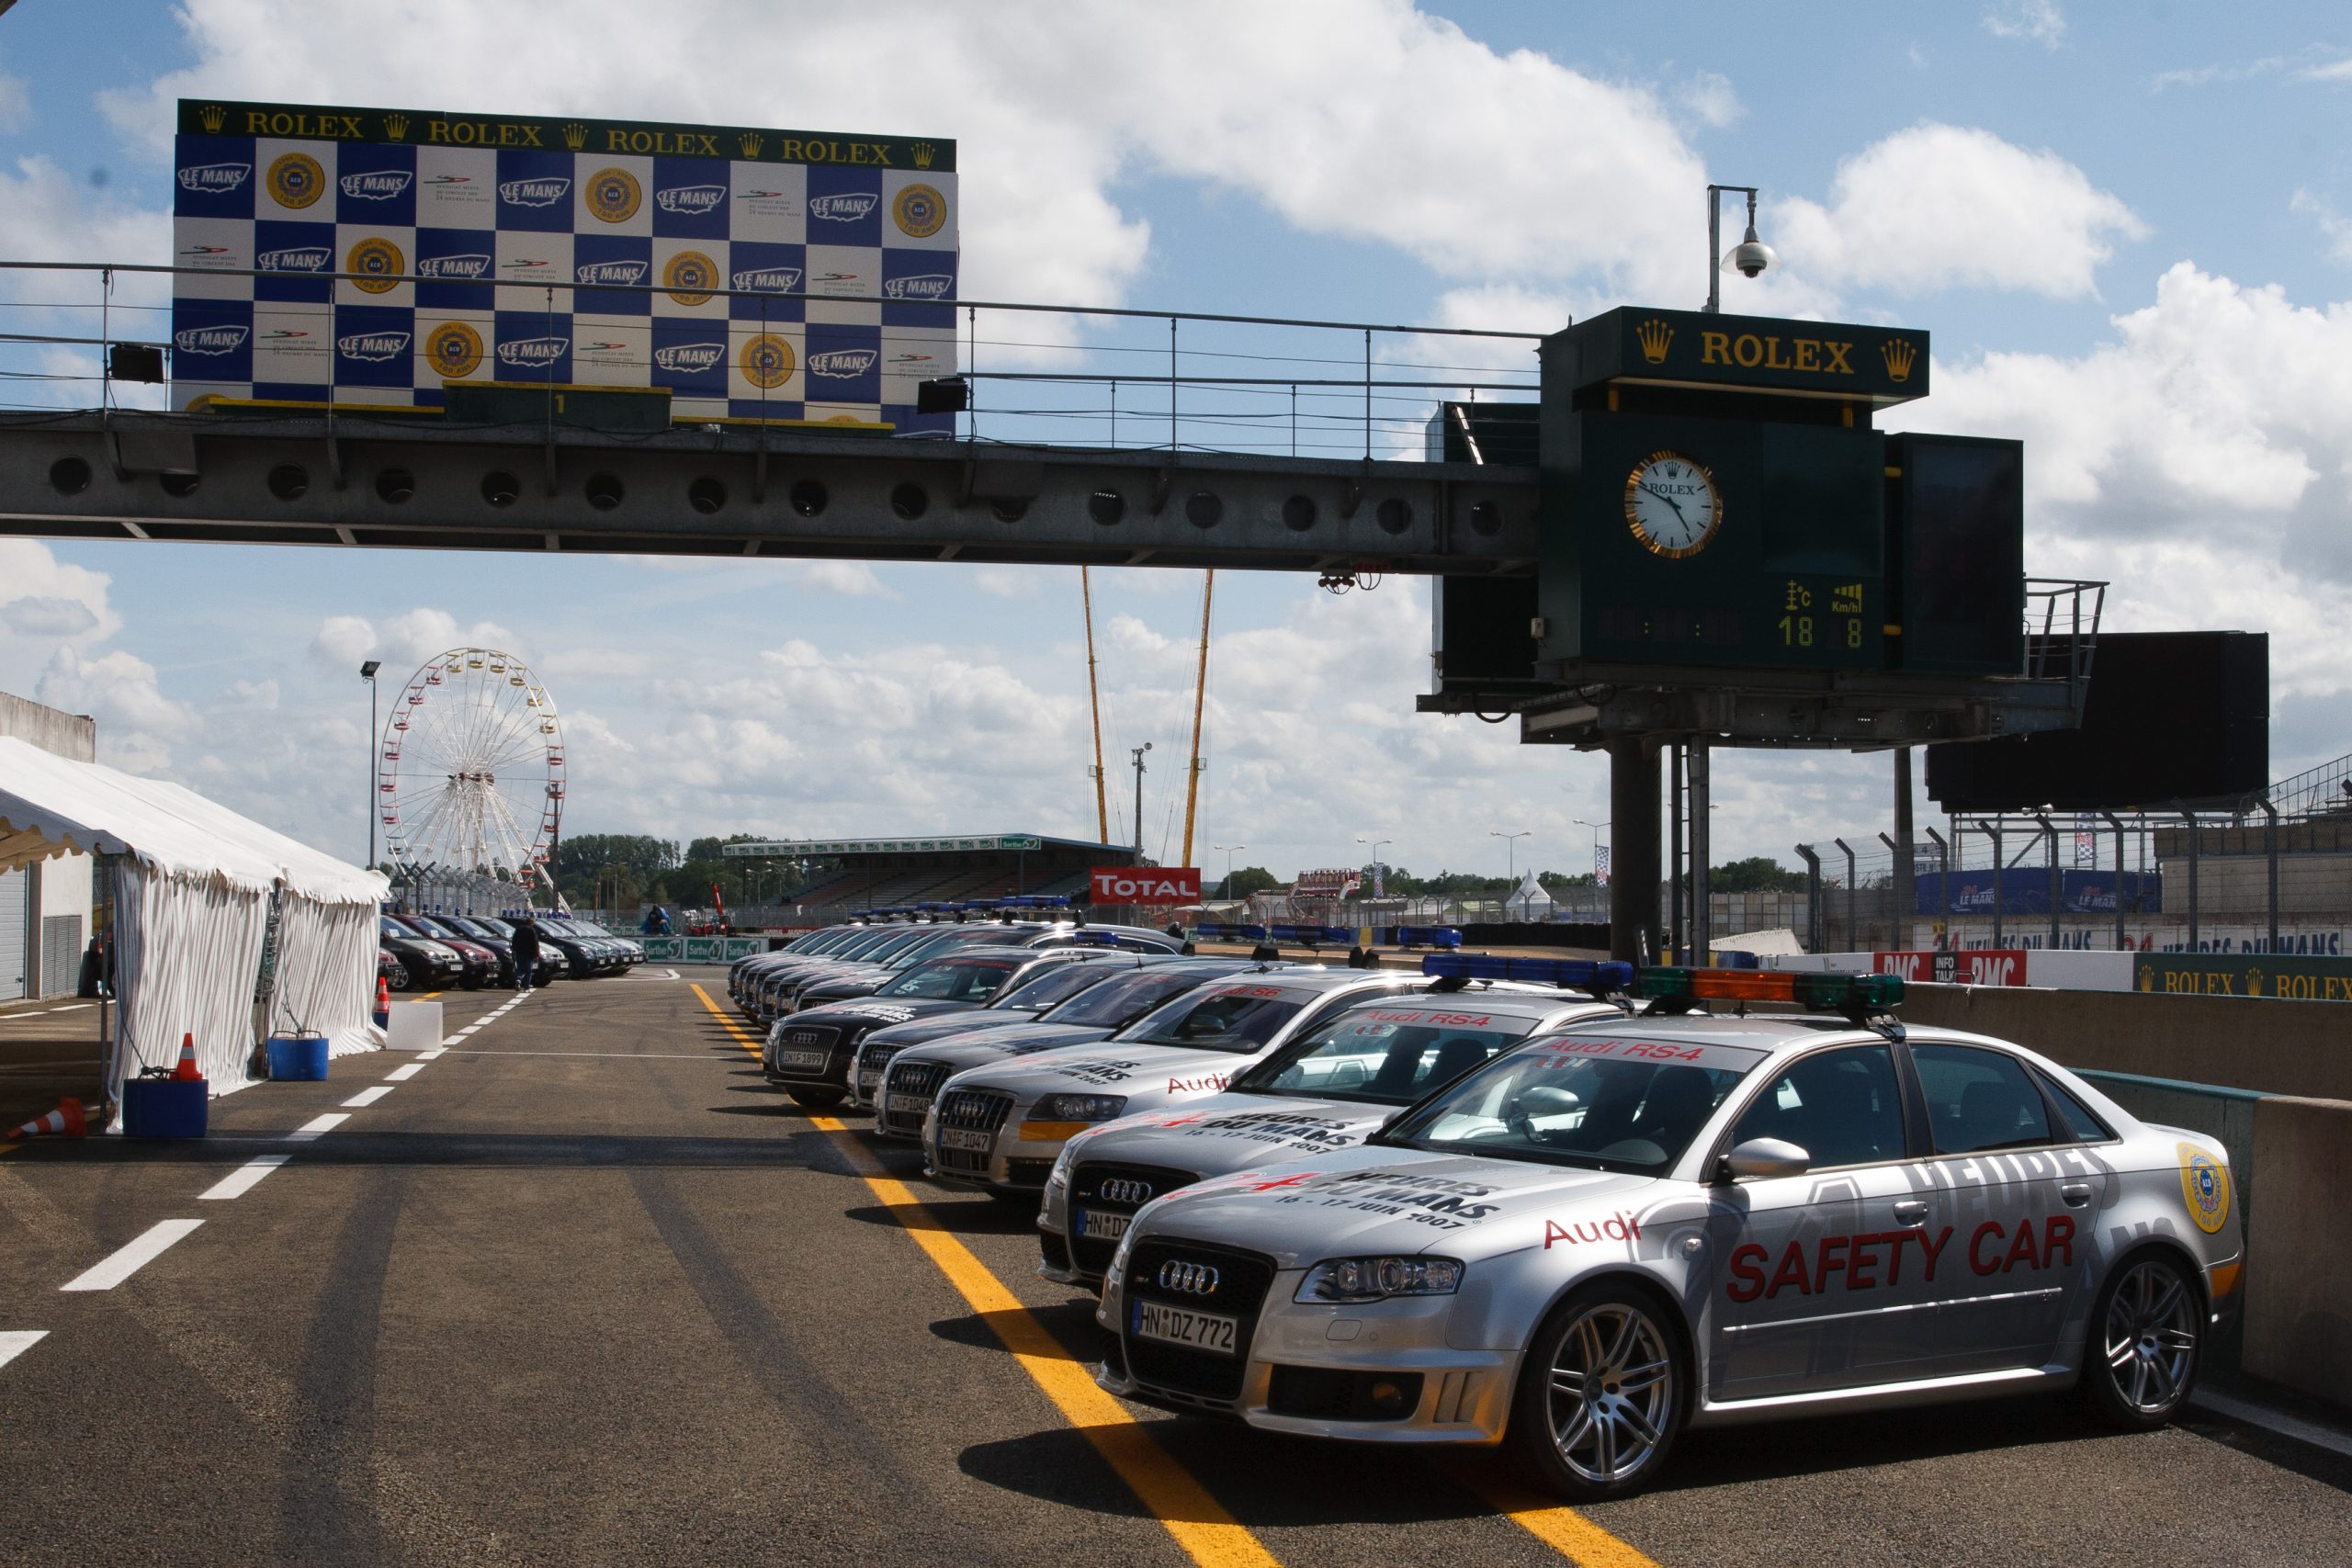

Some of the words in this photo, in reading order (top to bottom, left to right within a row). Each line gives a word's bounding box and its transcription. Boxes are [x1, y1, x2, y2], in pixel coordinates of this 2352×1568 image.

[246, 112, 364, 138] ROLEX
[429, 120, 543, 146] ROLEX
[607, 130, 719, 156] ROLEX
[782, 139, 892, 165] ROLEX
[184, 169, 198, 182] LE
[201, 170, 243, 183] MANS
[346, 176, 361, 190] LE
[364, 177, 403, 191] MANS
[505, 184, 520, 196] LE
[523, 184, 561, 197] MANS
[662, 191, 675, 204] LE
[679, 192, 718, 205] MANS
[815, 199, 830, 211] LE
[832, 199, 870, 213] MANS
[265, 254, 278, 266] LE
[282, 254, 322, 267] MANS
[425, 260, 439, 273] LE
[442, 262, 481, 275] MANS
[583, 266, 597, 278] LE
[601, 267, 639, 280] MANS
[739, 274, 752, 286] LE
[755, 275, 793, 288] MANS
[891, 280, 904, 292] LE
[908, 281, 944, 294] MANS
[182, 332, 196, 344] LE
[199, 333, 240, 346] MANS
[345, 338, 358, 350] LE
[362, 339, 401, 352] MANS
[504, 344, 518, 356] LE
[521, 344, 560, 357] MANS
[661, 349, 675, 362] LE
[677, 350, 716, 363] MANS
[1701, 332, 1854, 375] ROLEX
[815, 356, 828, 368] LE
[831, 356, 868, 369] MANS
[555, 394, 564, 413] 1
[1650, 483, 1695, 495] ROLEX
[1779, 616, 1813, 647] 18
[1848, 618, 1861, 648] 8
[1960, 896, 1970, 906] LE
[2091, 897, 2117, 908] MAN
[646, 944, 666, 955] Sarthe
[689, 946, 708, 955] Sarthe
[1936, 957, 1954, 968] INFO
[1935, 970, 1954, 982] TALK
[2165, 972, 2234, 995] ROLEX
[2276, 975, 2352, 1000] ROLEX
[1364, 1010, 1425, 1022] Audi
[1426, 1013, 1491, 1027] RS4
[1541, 1039, 1624, 1055] Audi
[1623, 1043, 1704, 1061] RS4
[802, 1054, 821, 1065] 1899
[1168, 1073, 1231, 1093] Audi
[1227, 1113, 1355, 1131] HEURES
[943, 1132, 952, 1144] IN
[963, 1134, 988, 1148] 1047
[1201, 1120, 1253, 1130] DU
[1253, 1122, 1356, 1146] MANS
[1244, 1134, 1285, 1144] JUIN
[1287, 1142, 1333, 1155] 2007
[1337, 1173, 1498, 1197] HEURES
[1364, 1186, 1501, 1219] MANS
[1274, 1195, 1293, 1203] 16
[1320, 1197, 1347, 1206] 17
[1349, 1201, 1406, 1215] JUIN
[1408, 1213, 1466, 1231] 2007
[1085, 1213, 1102, 1234] HN
[1544, 1210, 1642, 1249] Audi
[1726, 1225, 1954, 1304] SAFETY
[1968, 1214, 2075, 1276] CAR
[1141, 1305, 1159, 1336] HN
[1170, 1312, 1193, 1341] DZ
[1198, 1317, 1233, 1348] 772
